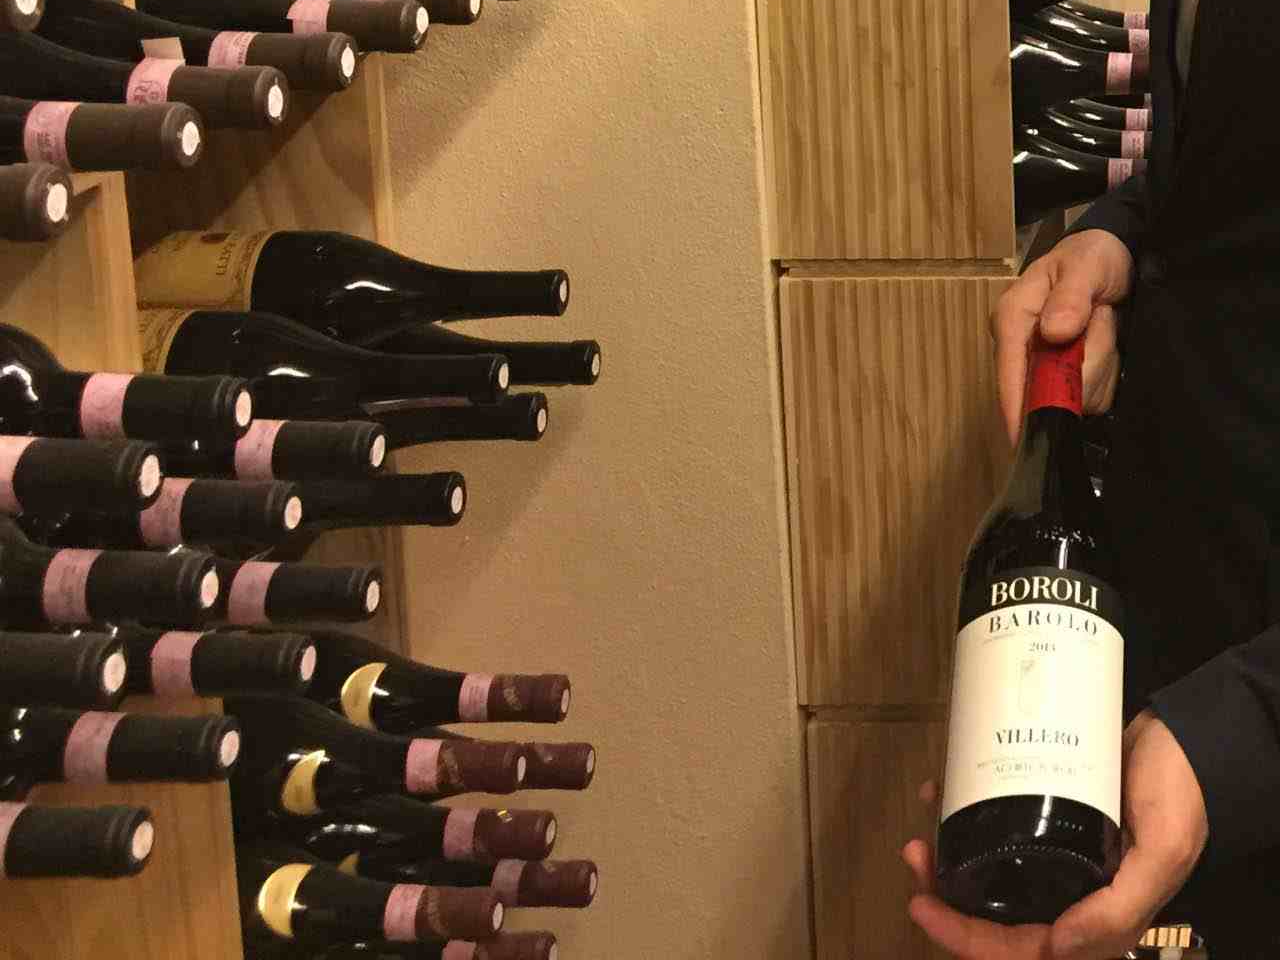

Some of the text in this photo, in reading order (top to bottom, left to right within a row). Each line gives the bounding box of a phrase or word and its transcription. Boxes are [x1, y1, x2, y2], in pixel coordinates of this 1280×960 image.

[990, 575, 1099, 612] BOROLI
[989, 609, 1098, 636] BAROLO
[994, 727, 1079, 747] VILLERO
